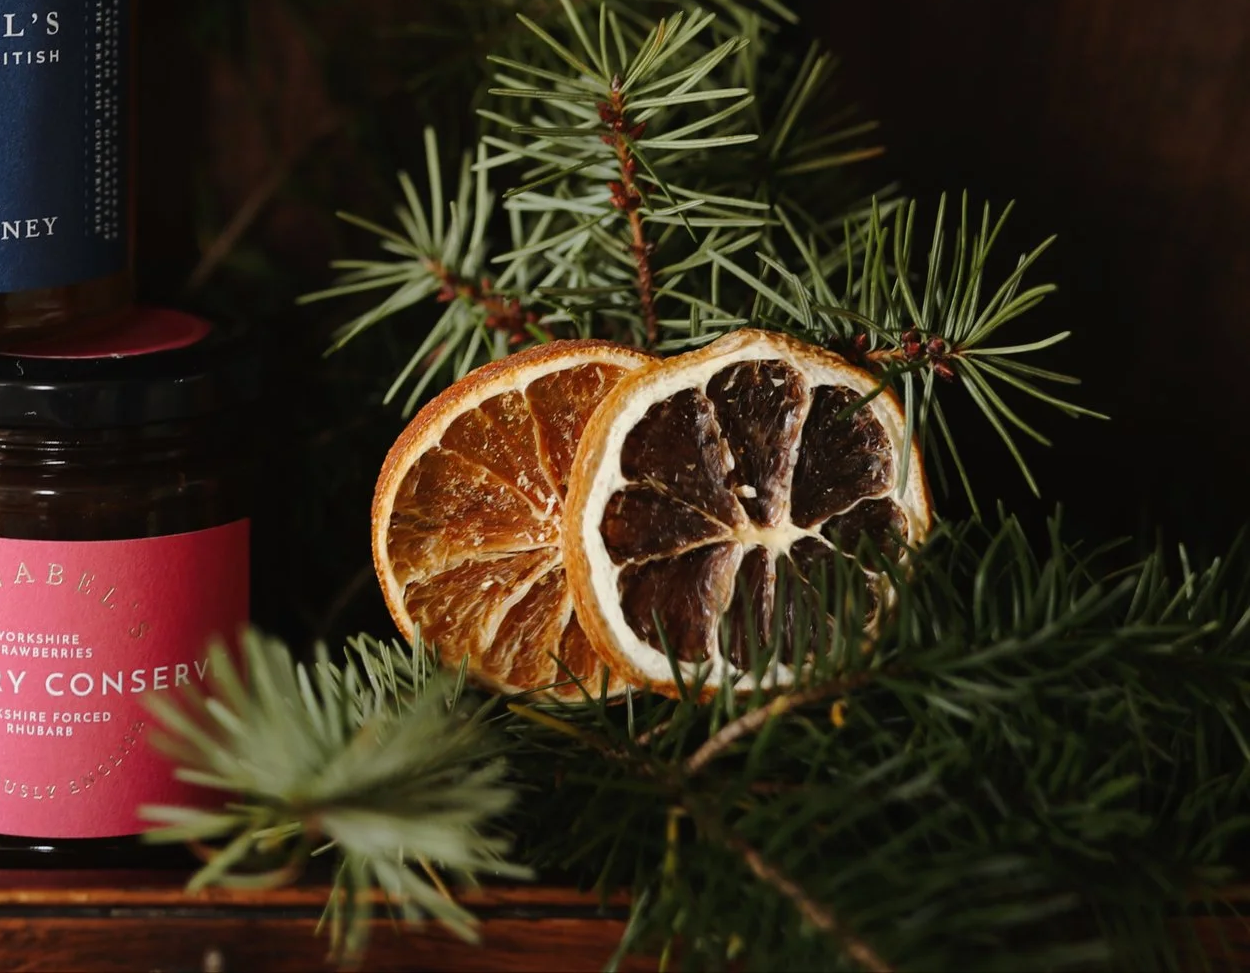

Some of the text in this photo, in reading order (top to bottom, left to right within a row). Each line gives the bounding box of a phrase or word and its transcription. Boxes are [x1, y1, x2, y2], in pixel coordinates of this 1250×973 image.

[94, 0, 103, 235] THE BRITISH COUNTRYSIDE
[44, 657, 211, 698] CONSERV
[5, 723, 74, 738] RHUBARB
[53, 710, 112, 724] FORCED
